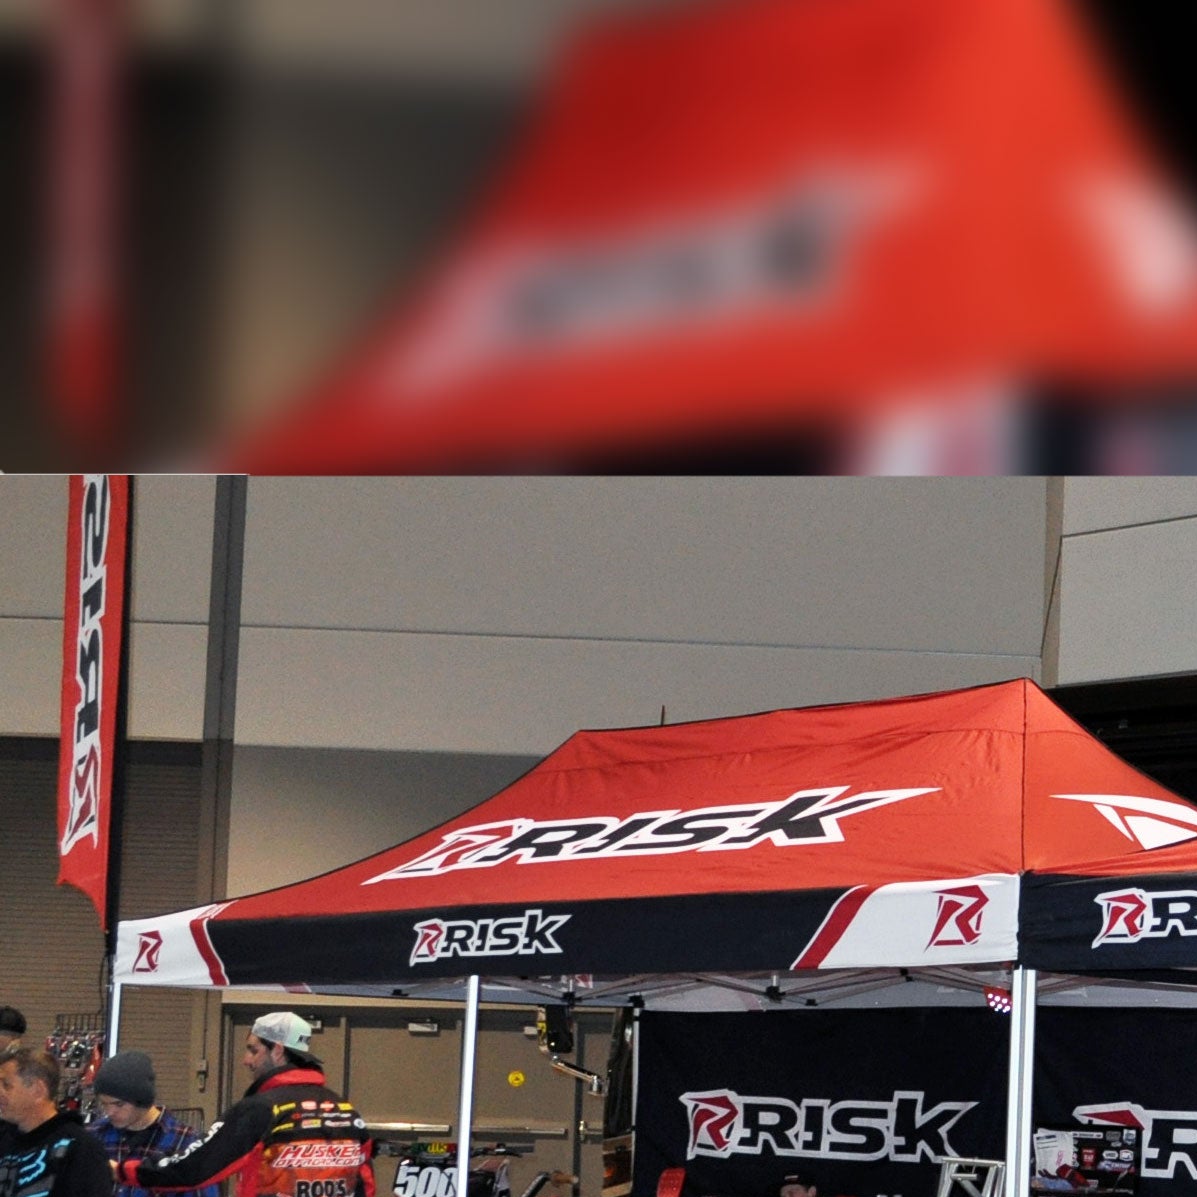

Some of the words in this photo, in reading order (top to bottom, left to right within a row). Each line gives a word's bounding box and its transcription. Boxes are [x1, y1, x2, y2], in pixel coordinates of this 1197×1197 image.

[480, 785, 942, 866] RISK
[440, 909, 573, 958] RISK
[734, 1091, 980, 1163] RISK
